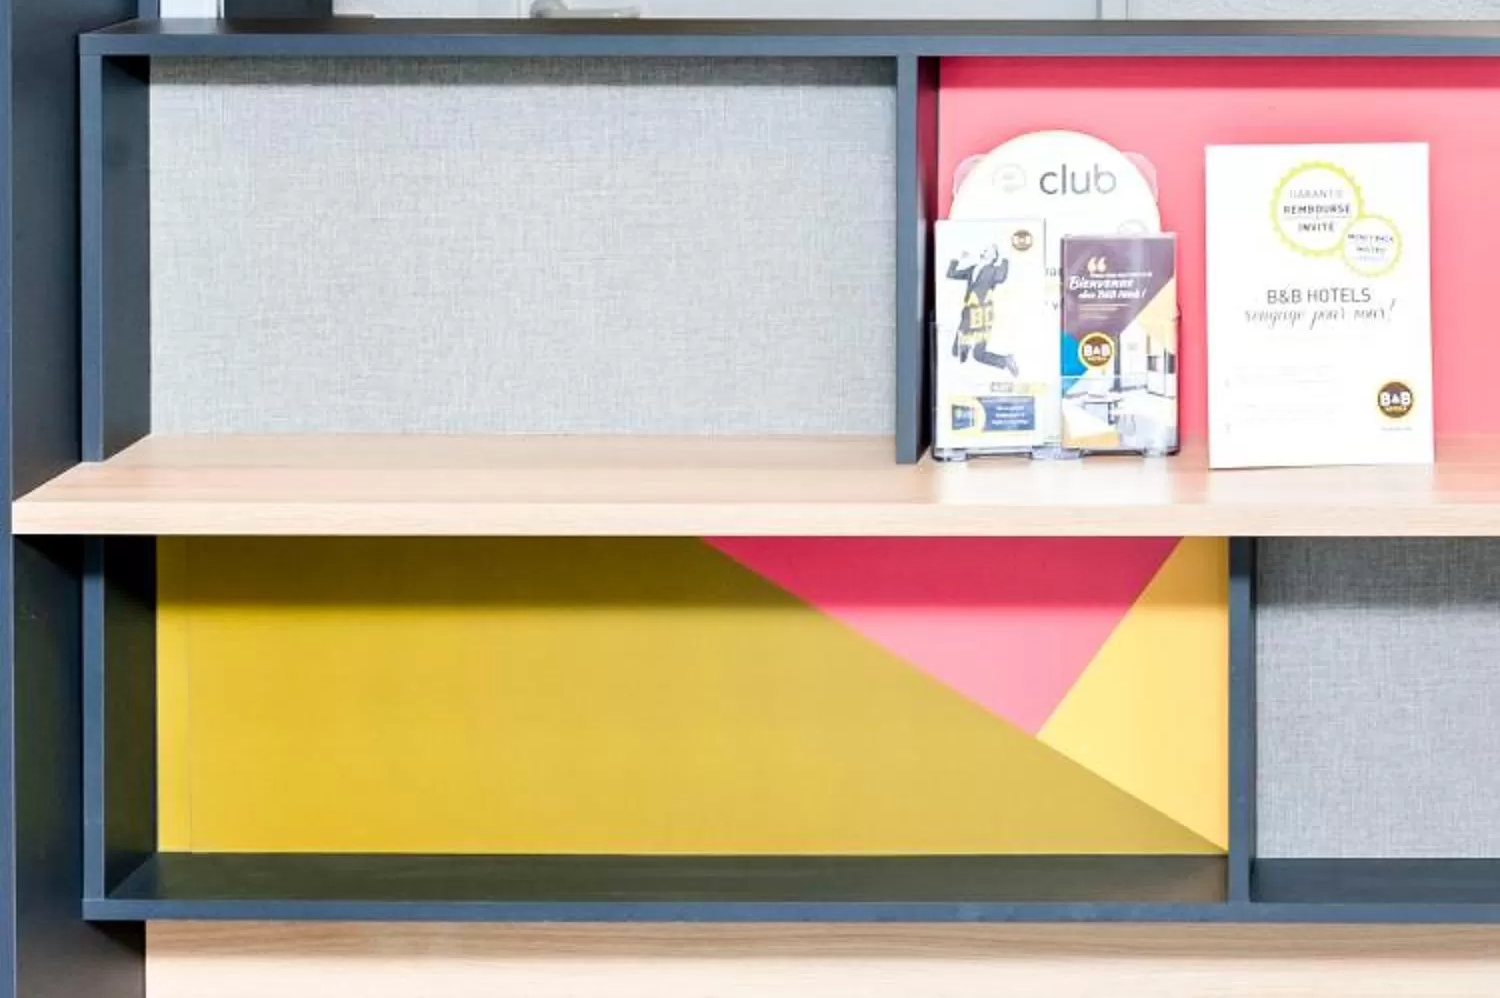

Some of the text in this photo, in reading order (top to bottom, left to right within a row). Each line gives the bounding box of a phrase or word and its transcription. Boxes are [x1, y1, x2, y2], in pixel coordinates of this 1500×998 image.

[1039, 163, 1117, 195] club
[1267, 287, 1371, 305] B&B HOTELS
